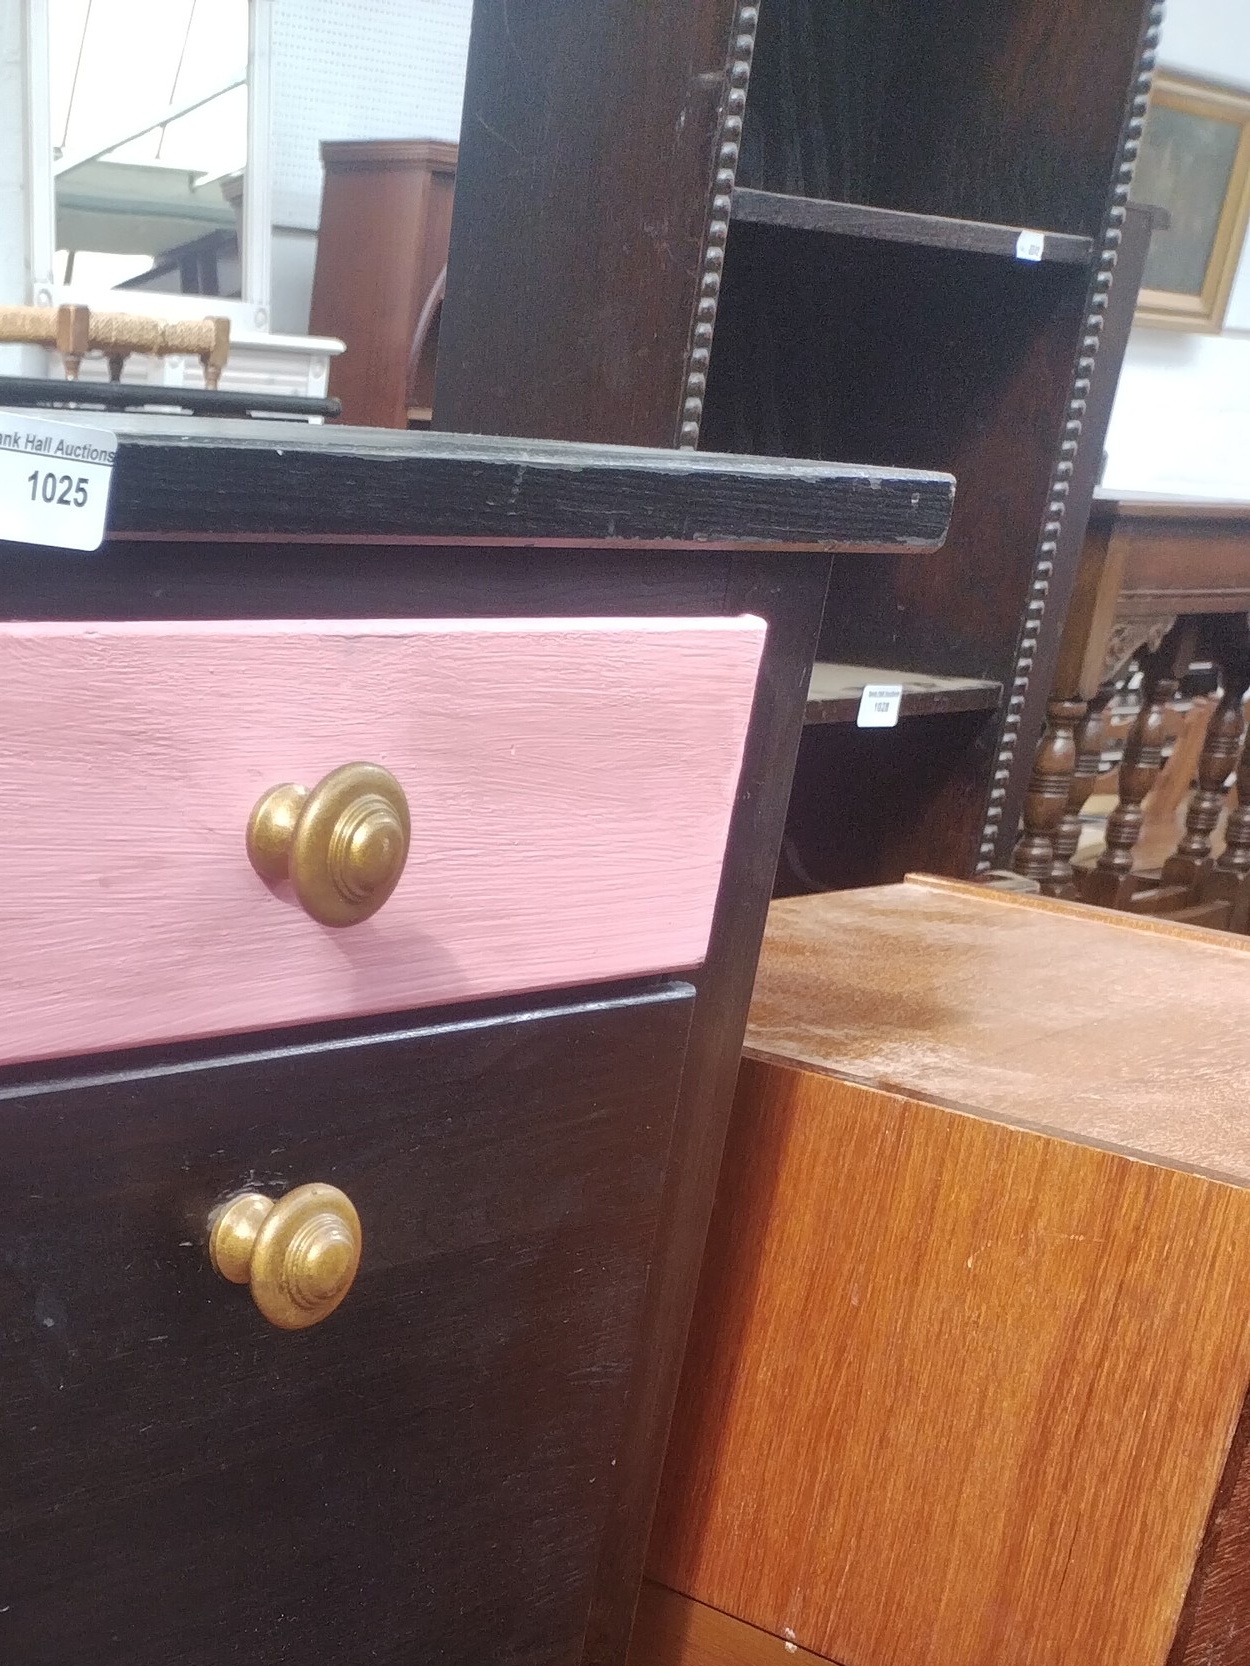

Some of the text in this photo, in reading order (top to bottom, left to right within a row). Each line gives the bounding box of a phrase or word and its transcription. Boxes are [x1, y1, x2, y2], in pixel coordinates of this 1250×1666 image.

[24, 433, 53, 453] Hall
[54, 439, 116, 463] Auctions
[28, 470, 90, 508] 1025
